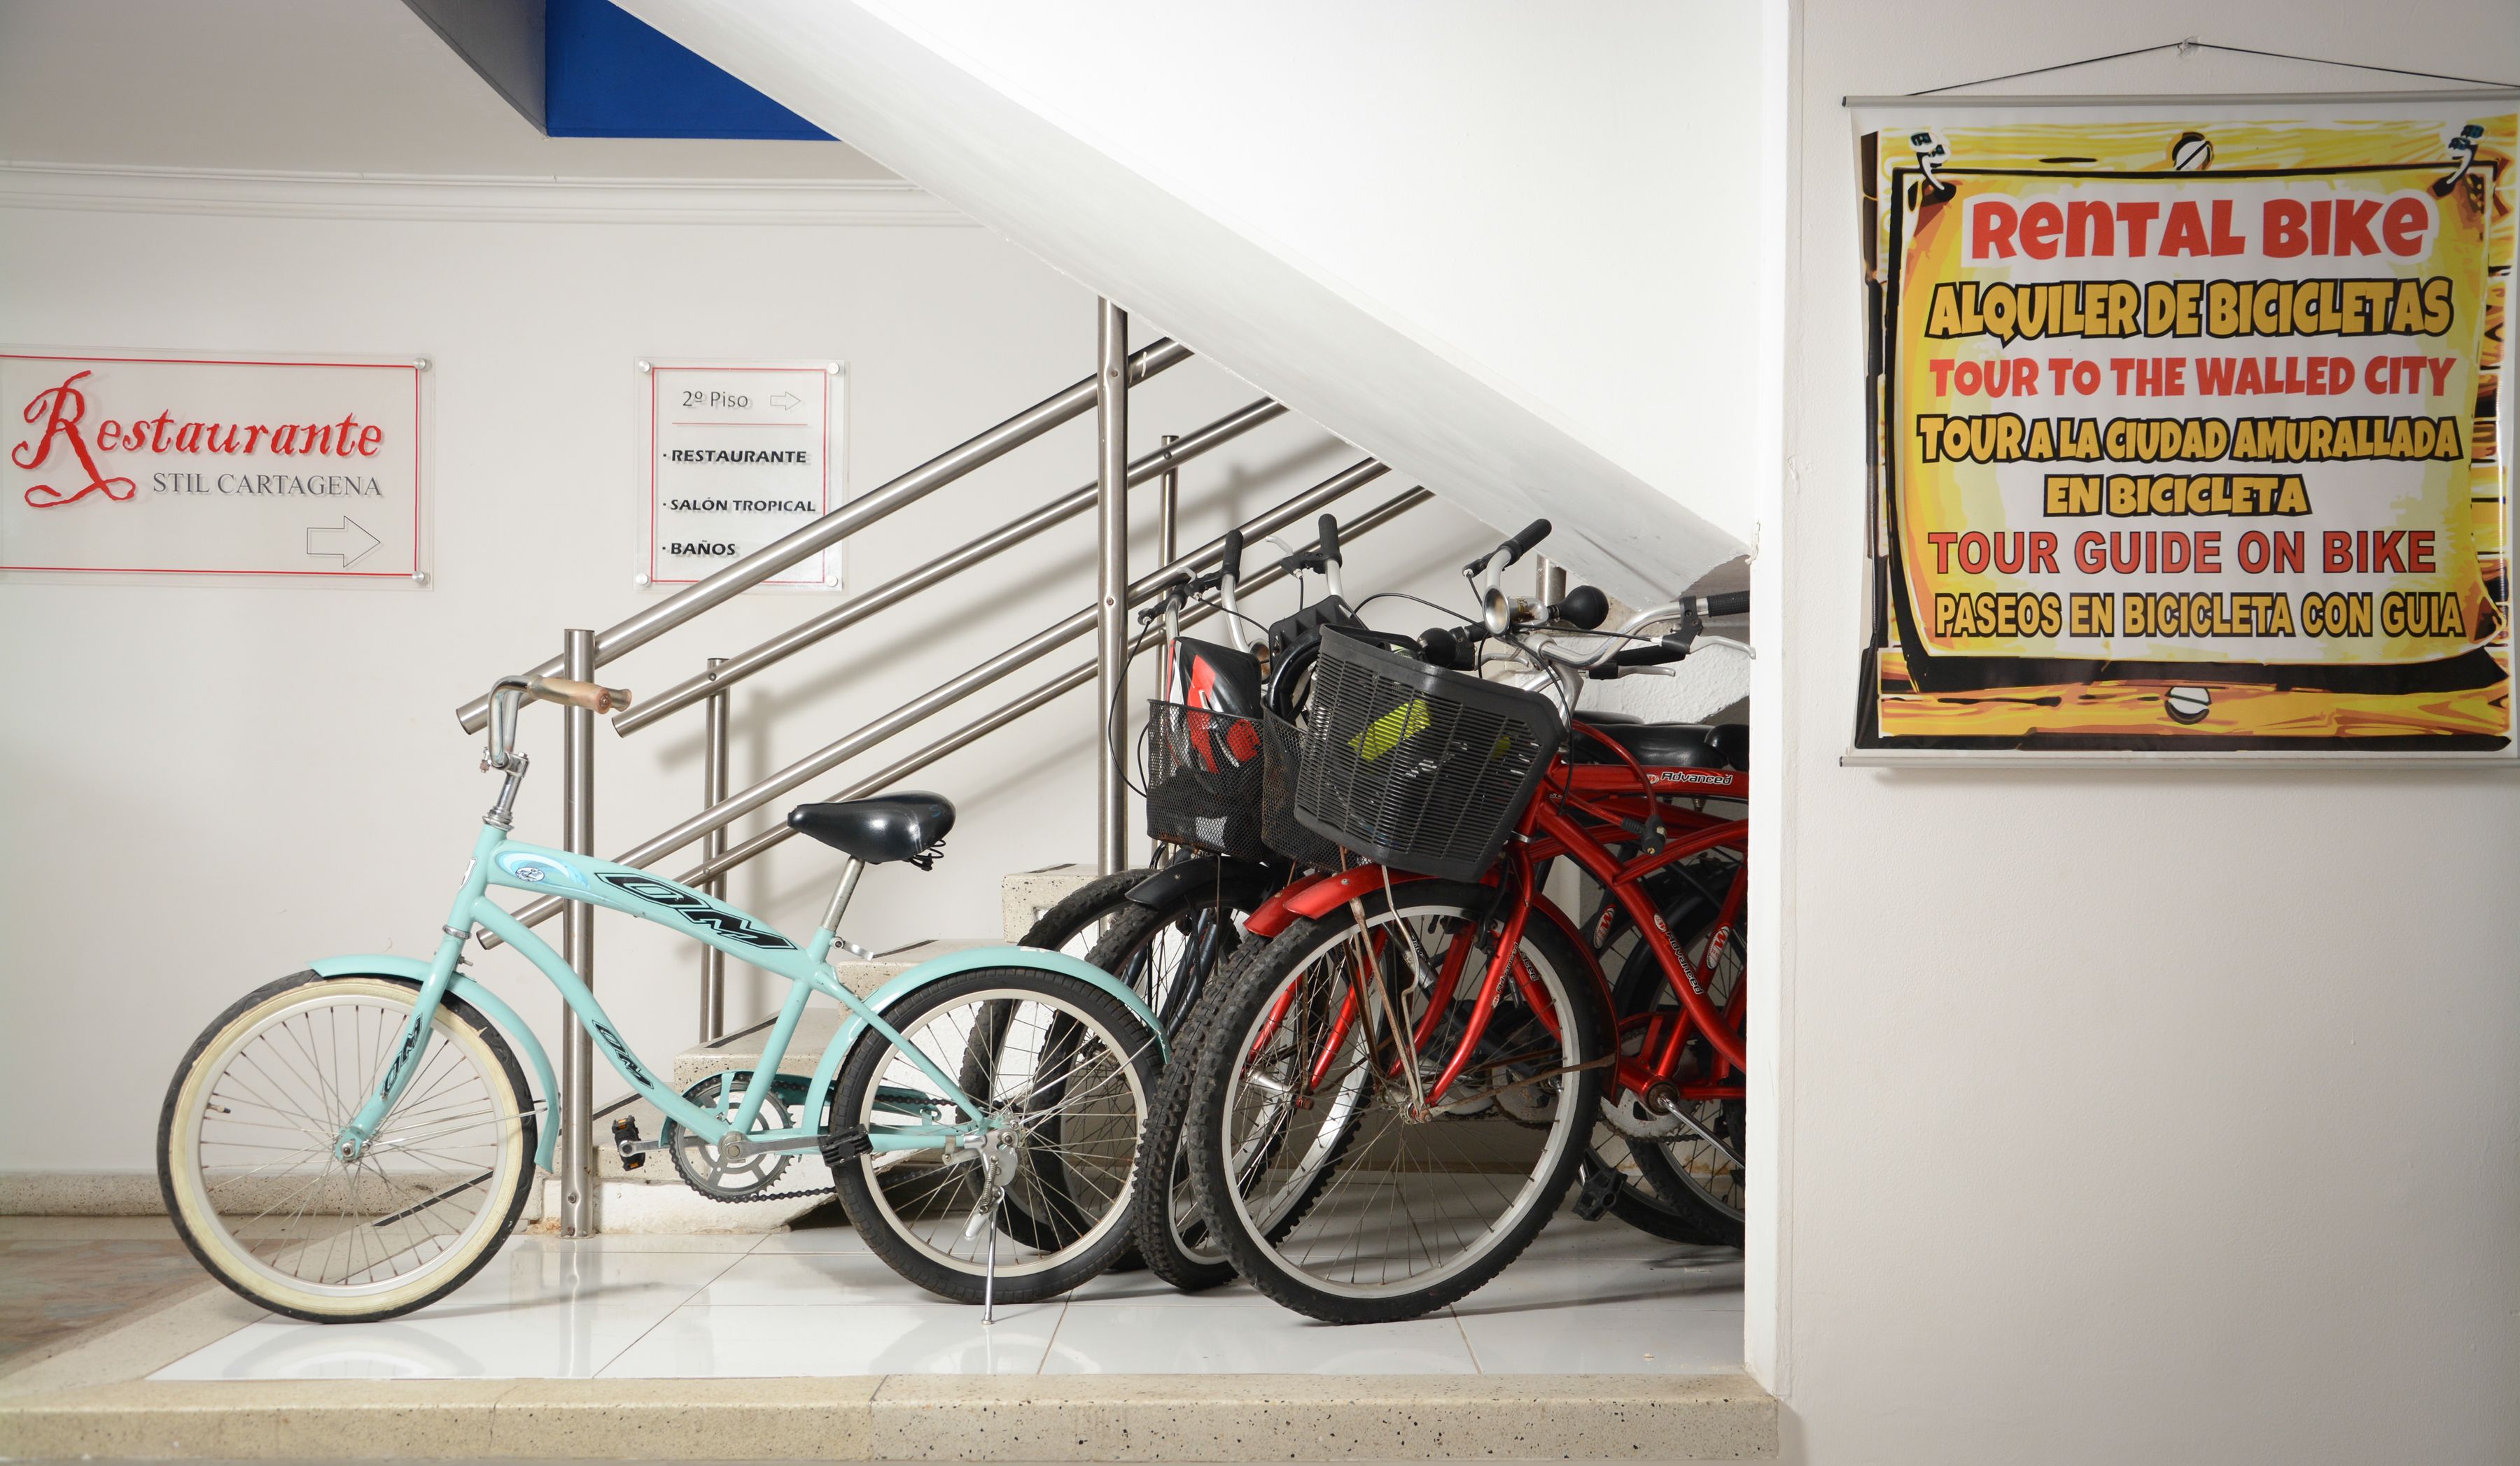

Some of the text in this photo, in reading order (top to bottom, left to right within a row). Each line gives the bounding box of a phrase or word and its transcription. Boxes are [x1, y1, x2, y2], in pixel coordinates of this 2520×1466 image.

[1924, 276, 2454, 349] ALQUILER DE BICICLETAS
[1929, 355, 2456, 398] TOUR TO THE WALLED CITY
[710, 390, 749, 408] Piso
[11, 370, 384, 508] Restaurante
[671, 449, 807, 463] RESTAURANTE
[1917, 412, 2464, 464] TOUR A LA CIUDAD AMURALLADA
[153, 472, 383, 495] STIL CARTAGENA
[670, 497, 816, 512] SALÓN TROPICAL
[2043, 473, 2313, 518] EN BICICLETA
[671, 540, 736, 556] BAÑOS
[1927, 530, 2436, 574] TOUR GUIDE ON BIKE
[1934, 591, 2467, 638] PASEOS EN BICICLETA CON GUIA
[1660, 771, 1733, 785] Advanced
[1667, 931, 1704, 994] Advanced
